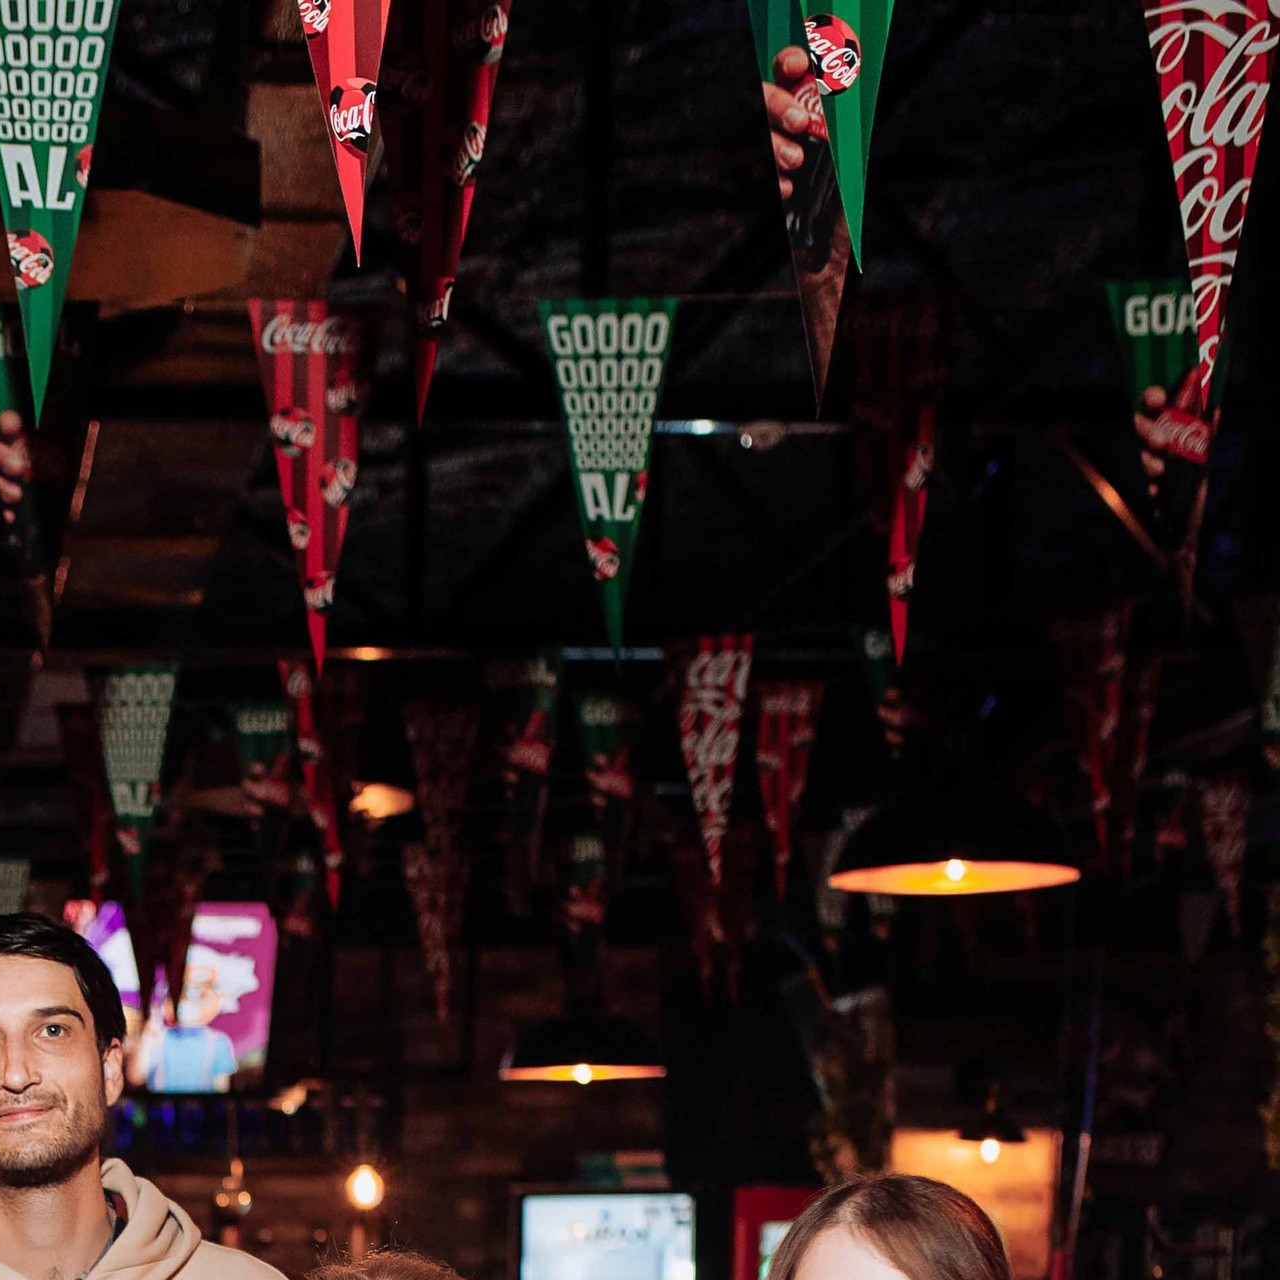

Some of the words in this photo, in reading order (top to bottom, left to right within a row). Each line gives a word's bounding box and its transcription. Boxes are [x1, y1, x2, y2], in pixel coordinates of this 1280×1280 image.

[0, 143, 76, 210] AL
[548, 313, 669, 355] GOOOO
[1125, 294, 1198, 337] GOA
[580, 472, 635, 521] AL
